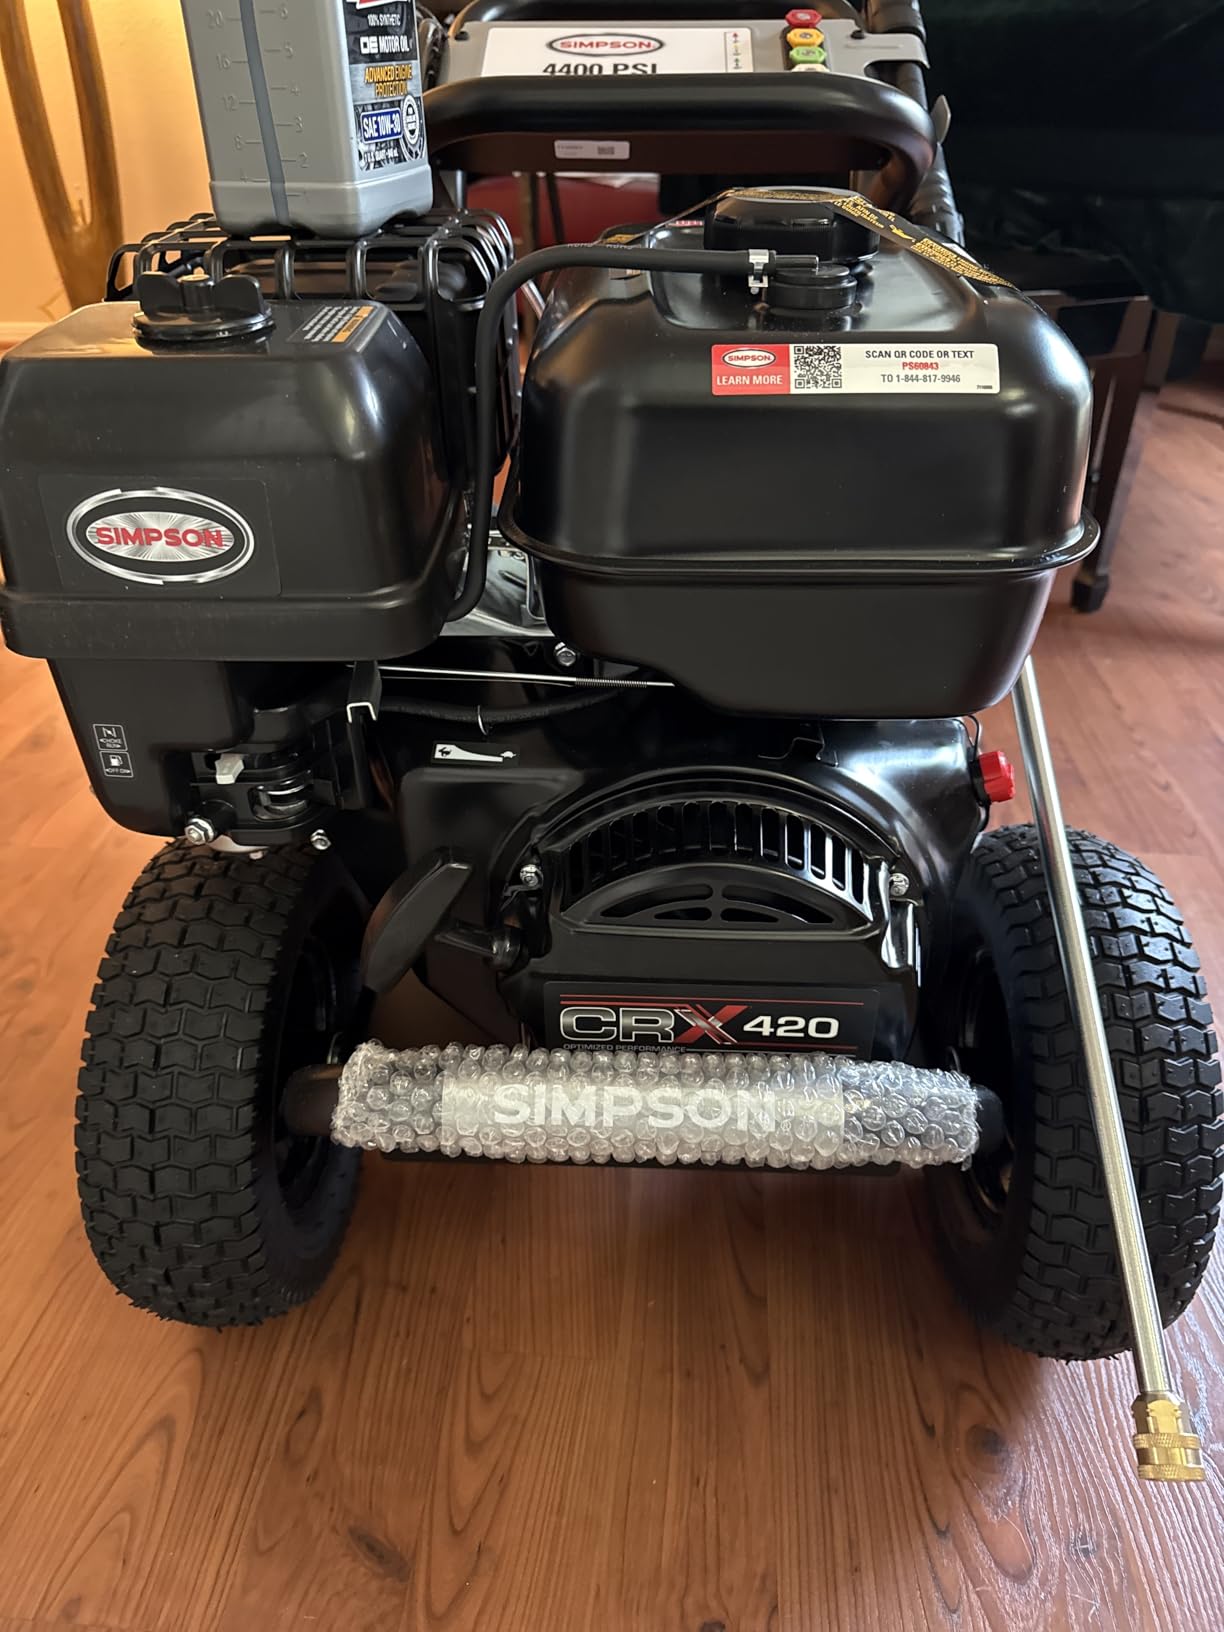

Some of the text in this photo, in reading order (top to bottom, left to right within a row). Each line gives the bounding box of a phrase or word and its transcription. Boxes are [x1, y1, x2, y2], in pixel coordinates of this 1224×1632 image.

[379, 35, 400, 53] MOTOR
[400, 34, 410, 52] OIL
[559, 40, 653, 49] SIMPSON
[365, 63, 412, 83] ADVANCED ENGINE
[542, 63, 658, 76] 4400 PSI
[375, 81, 408, 97] PROTECTION
[363, 115, 378, 138] SAE
[378, 113, 401, 136] 10W-30
[728, 354, 771, 362] SIMPSON
[865, 350, 974, 359] SCAN QR CODE OR TEXT
[902, 362, 939, 370] PS60843
[716, 375, 783, 386] LEARN MORE
[880, 374, 961, 383] TO 1-844-817-9946
[95, 527, 225, 548] SIMPSON
[559, 1004, 839, 1046] CRX 420
[562, 1043, 687, 1053] OPTIMIZED PERFORMANCE
[493, 1083, 776, 1132] SIMPSON
